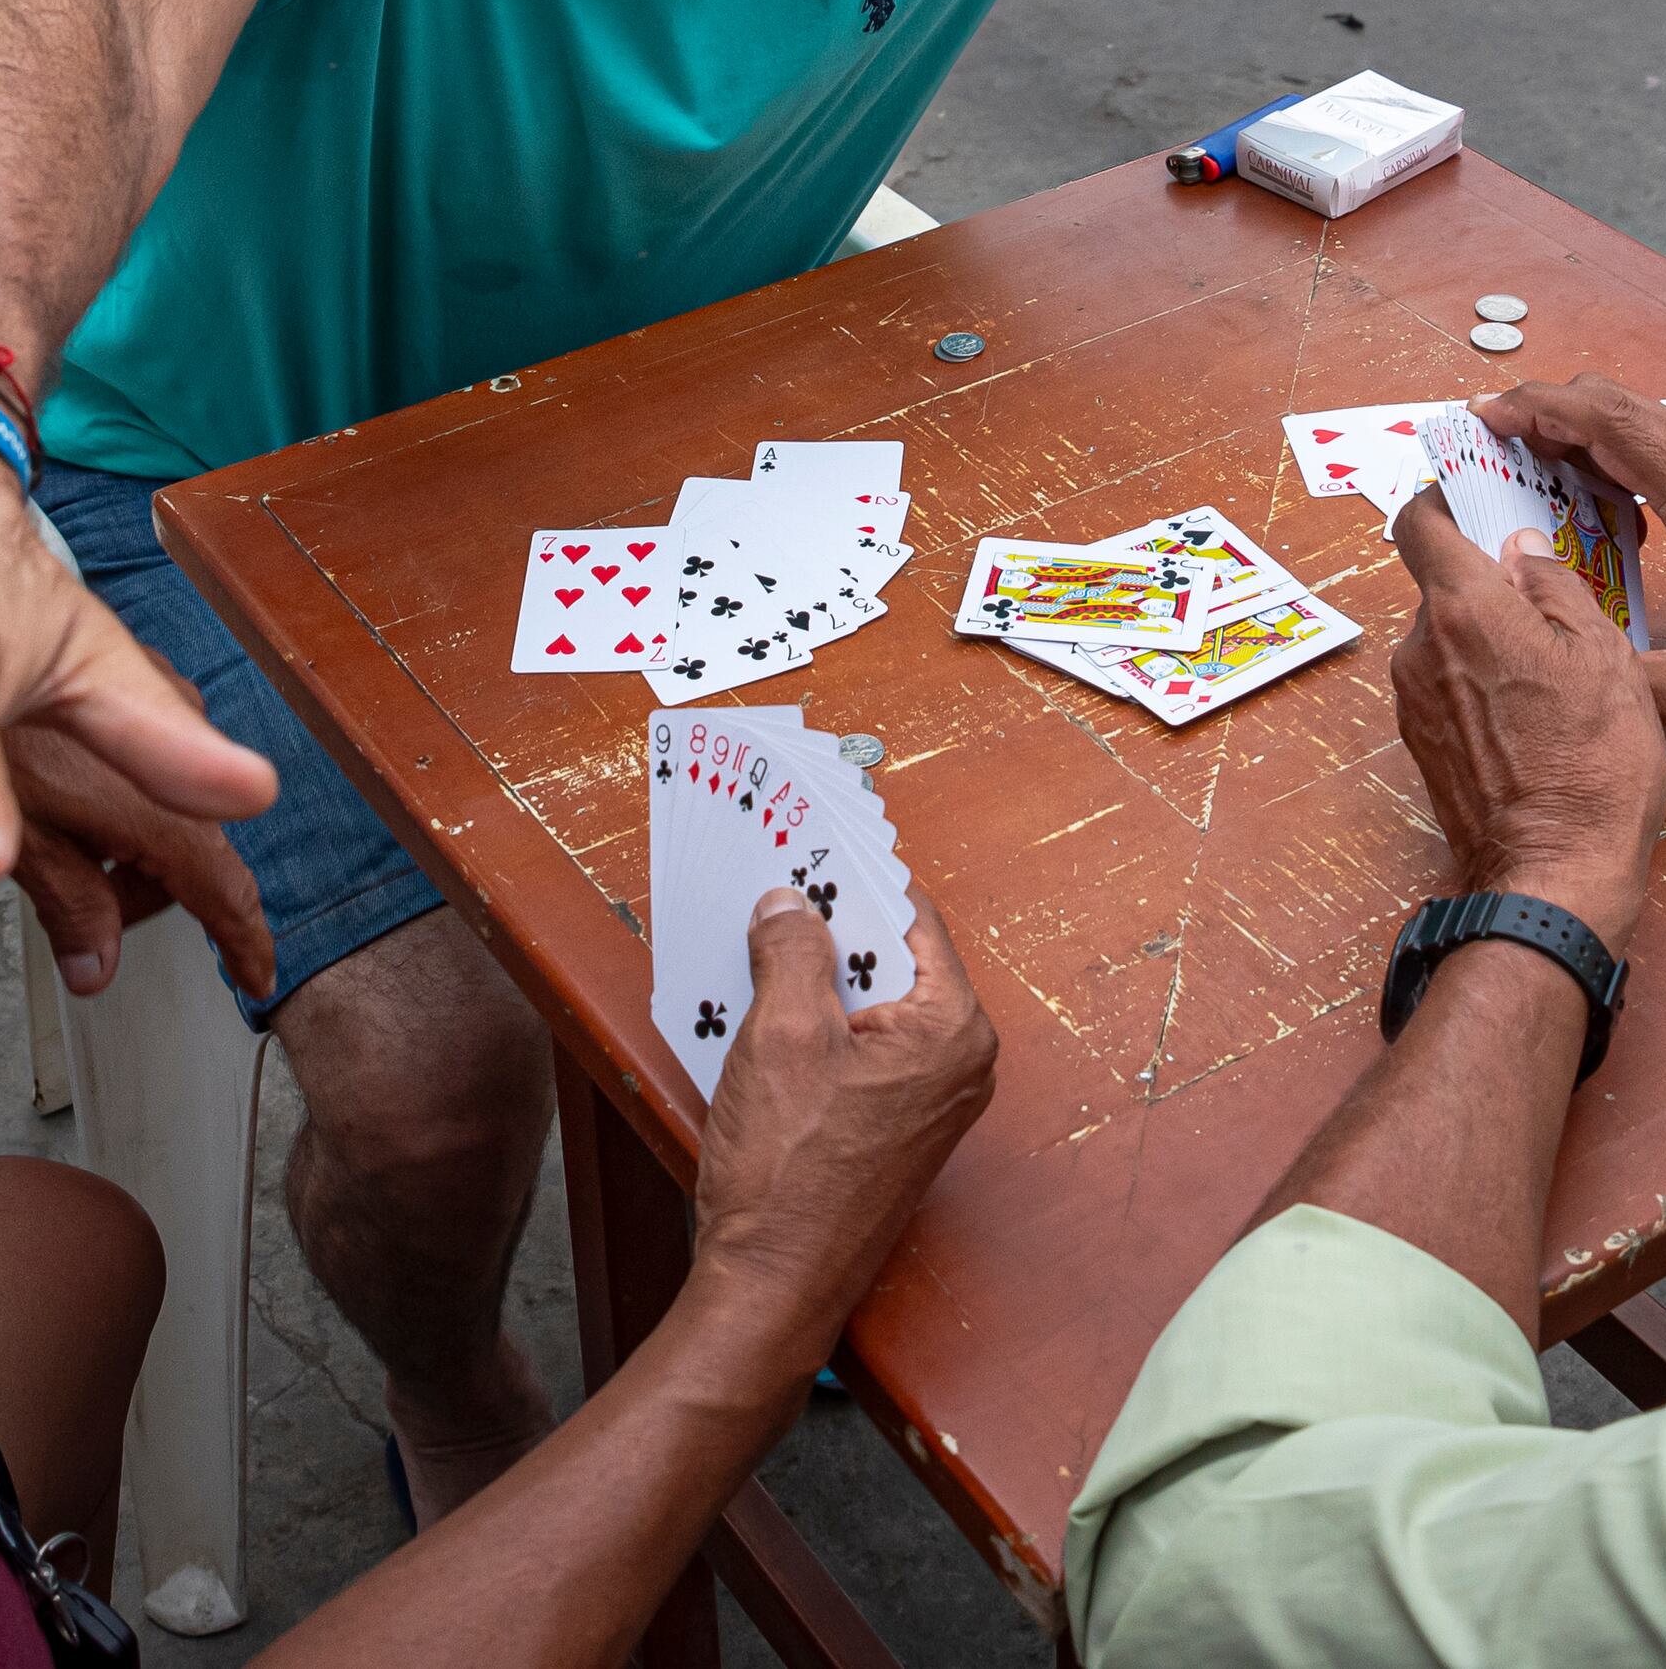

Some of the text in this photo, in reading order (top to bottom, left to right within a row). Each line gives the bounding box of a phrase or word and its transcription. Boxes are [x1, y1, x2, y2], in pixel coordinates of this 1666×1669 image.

[1383, 144, 1430, 179] CARNIVAL
[1246, 150, 1315, 194] CARNIVAL
[761, 447, 778, 460] A
[1511, 442, 1523, 467] 5
[875, 495, 899, 506] 2
[1186, 515, 1211, 524] J
[541, 536, 558, 551] 7
[876, 543, 901, 557] 2
[1180, 559, 1203, 572] J
[852, 597, 875, 614] 3
[830, 613, 847, 630] 7
[966, 618, 991, 630] J
[649, 646, 666, 662] 7
[787, 643, 803, 661] 7
[1170, 703, 1196, 713] J
[655, 724, 671, 754] 9
[689, 724, 707, 754] 8
[712, 735, 730, 766] 9
[749, 757, 768, 791] Q
[769, 781, 791, 806] A
[786, 796, 810, 827] 3
[810, 848, 830, 871] 4
